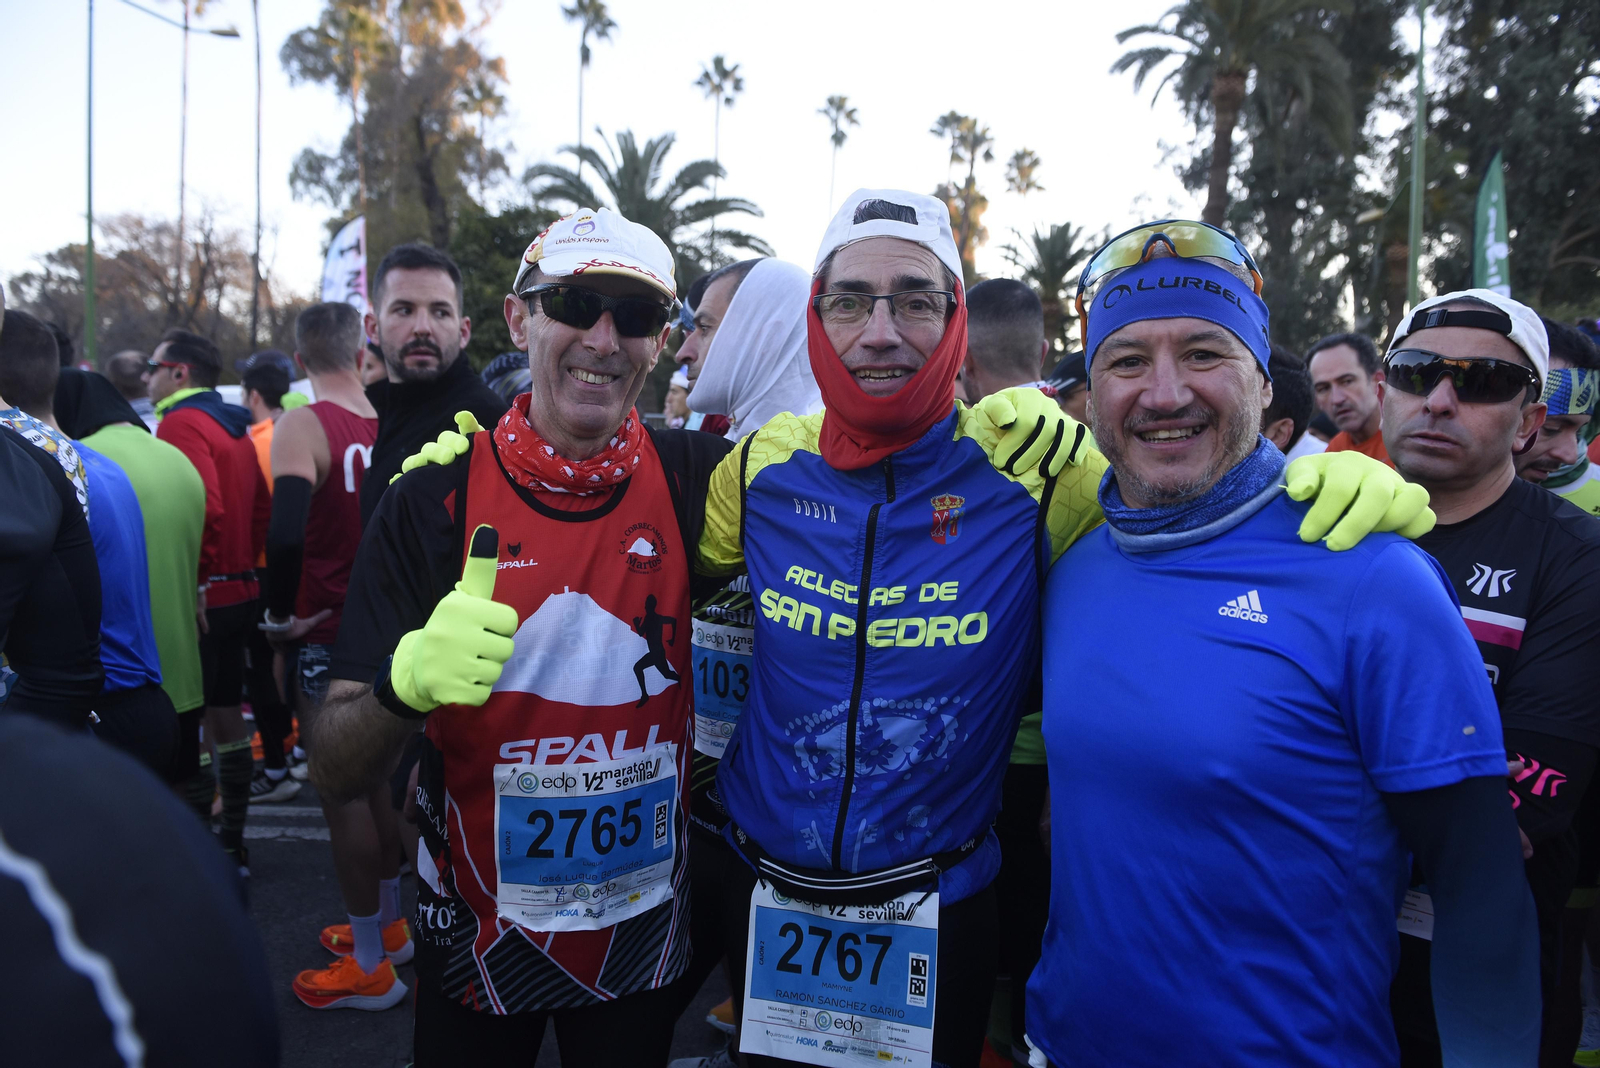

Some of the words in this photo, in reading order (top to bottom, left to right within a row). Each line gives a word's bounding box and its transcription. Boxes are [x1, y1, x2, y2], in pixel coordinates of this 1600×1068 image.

[1136, 276, 1248, 314] LURBEL
[794, 498, 837, 524] GOBIK
[496, 558, 538, 570] SPALL
[625, 554, 662, 570] Martos
[785, 565, 907, 606] ATLETAS
[918, 581, 959, 603] DE
[760, 588, 823, 636] SAN
[827, 611, 988, 648] PEDRO
[1218, 606, 1269, 624] adidas
[705, 631, 724, 648] edp
[541, 771, 577, 793] edp
[600, 758, 653, 781] maratón
[615, 769, 653, 788] sevilla
[526, 797, 642, 858] 2765
[538, 874, 562, 883] José
[565, 872, 598, 882] Luque
[601, 860, 644, 879] Bermúdez
[582, 860, 604, 868] Luque
[592, 880, 616, 899] edp
[555, 909, 579, 918] HOKA
[858, 909, 905, 921] sevilla
[776, 922, 893, 986] 2767
[821, 981, 853, 993] MAMIYNE
[775, 989, 815, 1004] RAMON
[817, 995, 867, 1013] SANCHEZ
[834, 1015, 863, 1036] edp
[796, 1036, 818, 1048] HOKA
